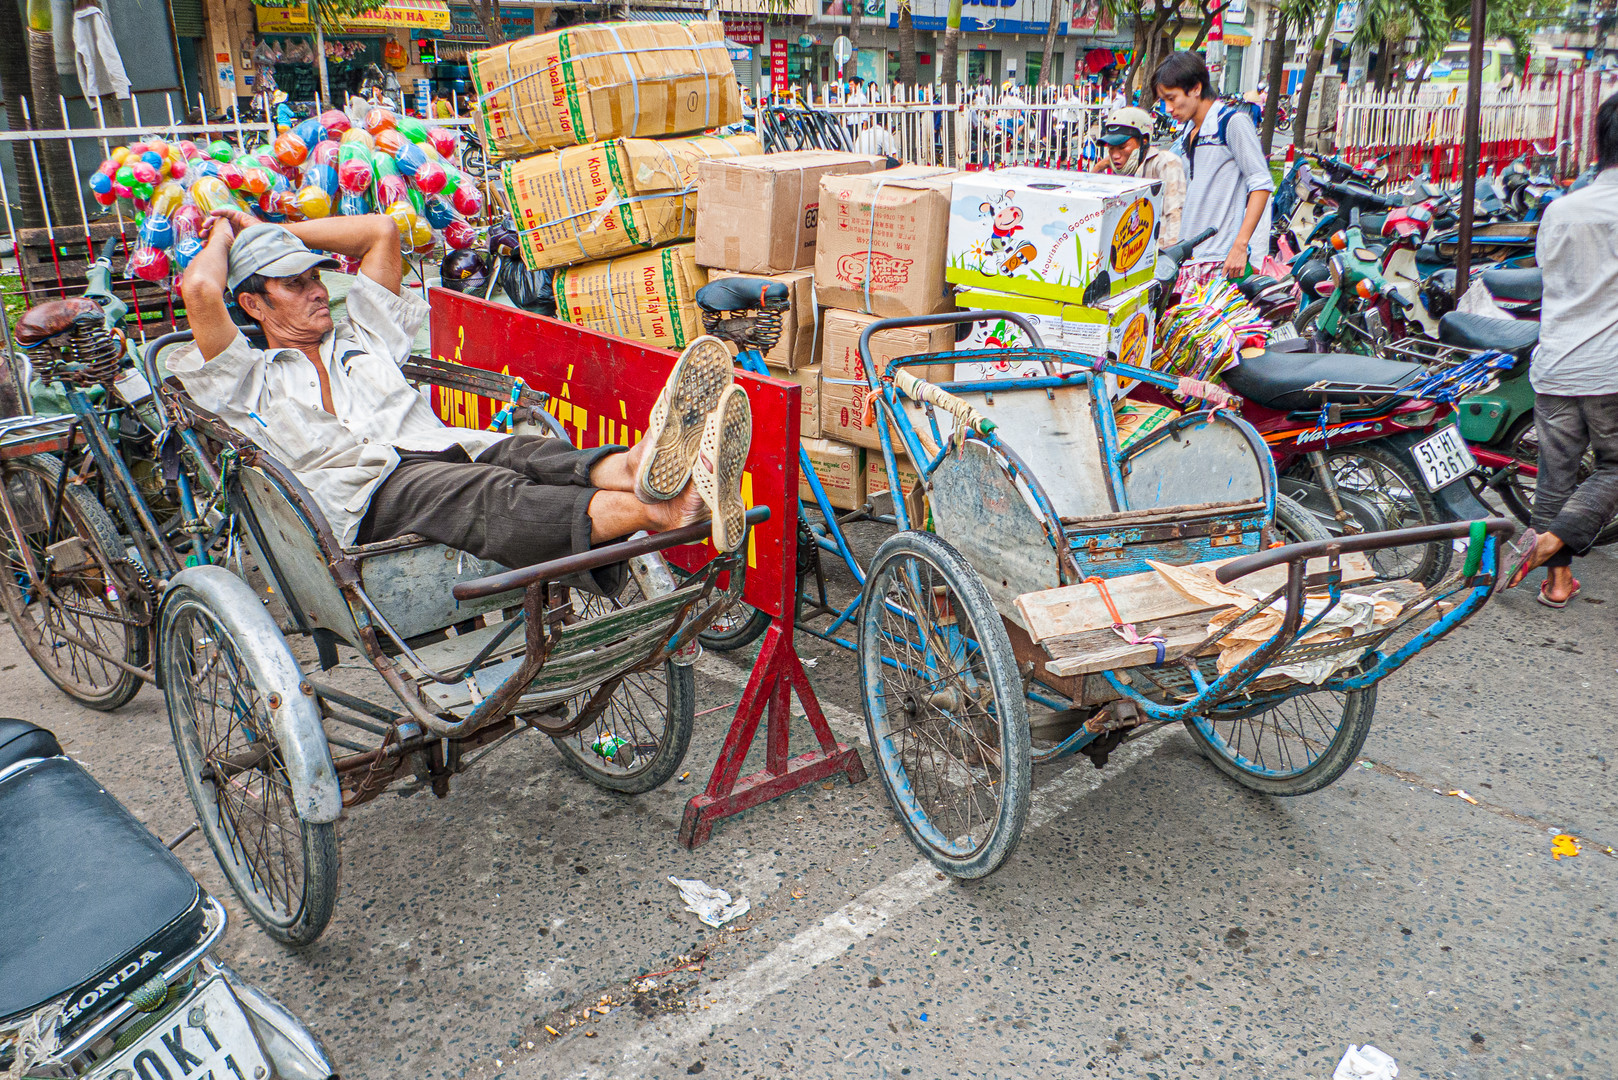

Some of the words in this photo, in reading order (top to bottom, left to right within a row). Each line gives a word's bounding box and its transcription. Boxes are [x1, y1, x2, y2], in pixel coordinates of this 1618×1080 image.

[406, 10, 425, 22] HÀ
[547, 56, 563, 87] Khoai
[552, 87, 565, 107] Tây
[558, 108, 573, 132] Tươi
[587, 157, 605, 187] Khoai
[1041, 232, 1069, 276] Nourishing
[643, 266, 659, 295] Khoai
[646, 296, 660, 314] Tây
[651, 315, 668, 338] Tươi
[1430, 451, 1468, 486] 2361
[61, 950, 162, 1028] HONDA
